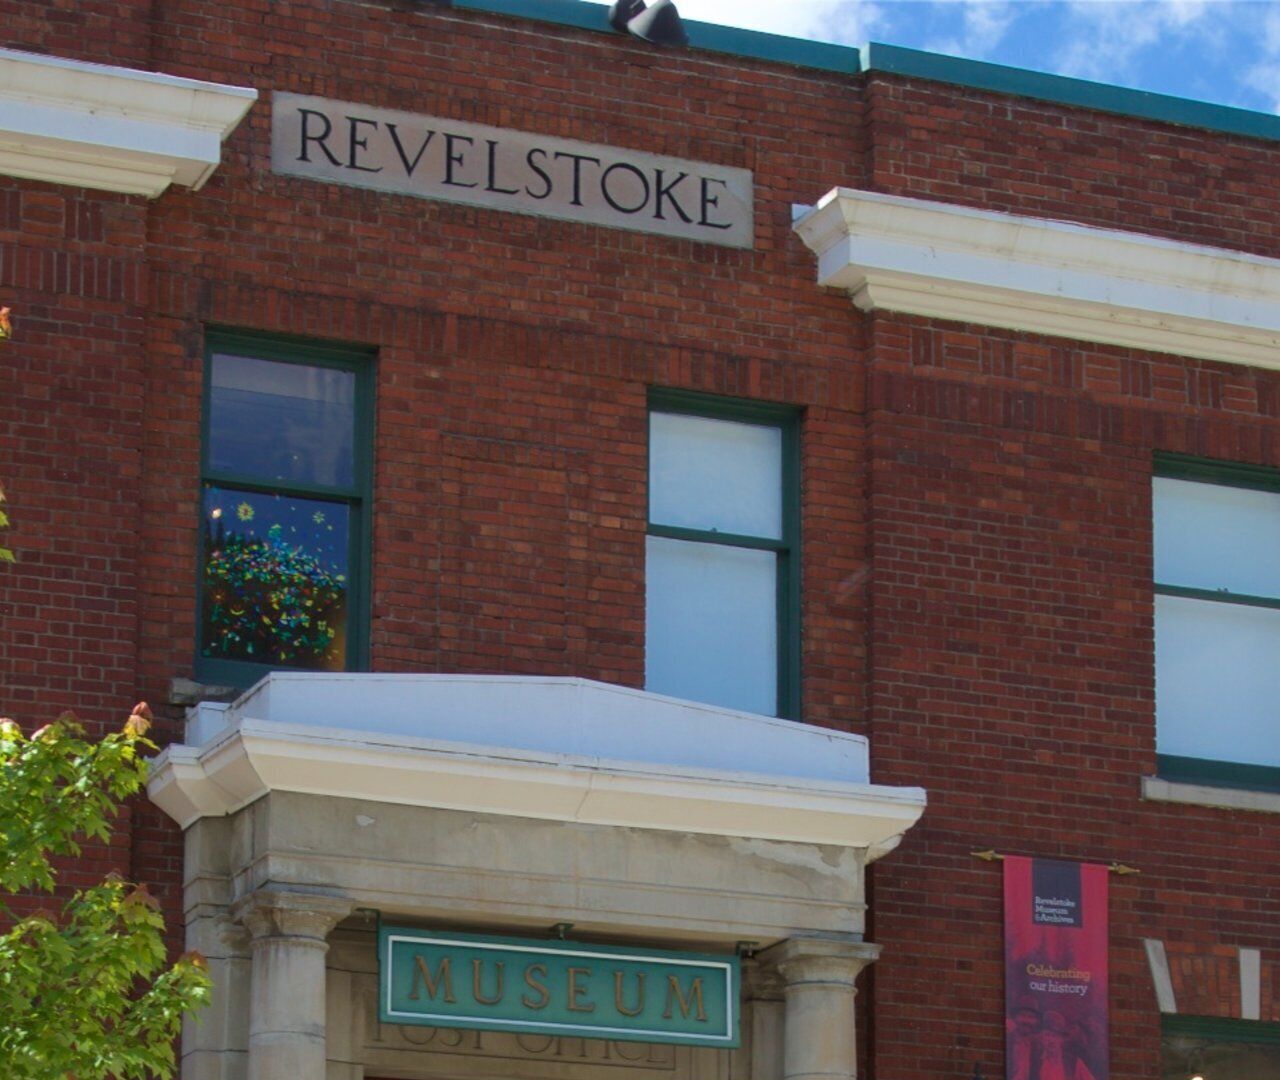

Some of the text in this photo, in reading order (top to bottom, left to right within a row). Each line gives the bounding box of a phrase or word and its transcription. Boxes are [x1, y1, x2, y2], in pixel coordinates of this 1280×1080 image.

[296, 108, 732, 229] REVELSTOKE
[410, 955, 708, 1022] MUSEUM
[1026, 964, 1091, 982] Celebrating
[1029, 980, 1088, 996] our history
